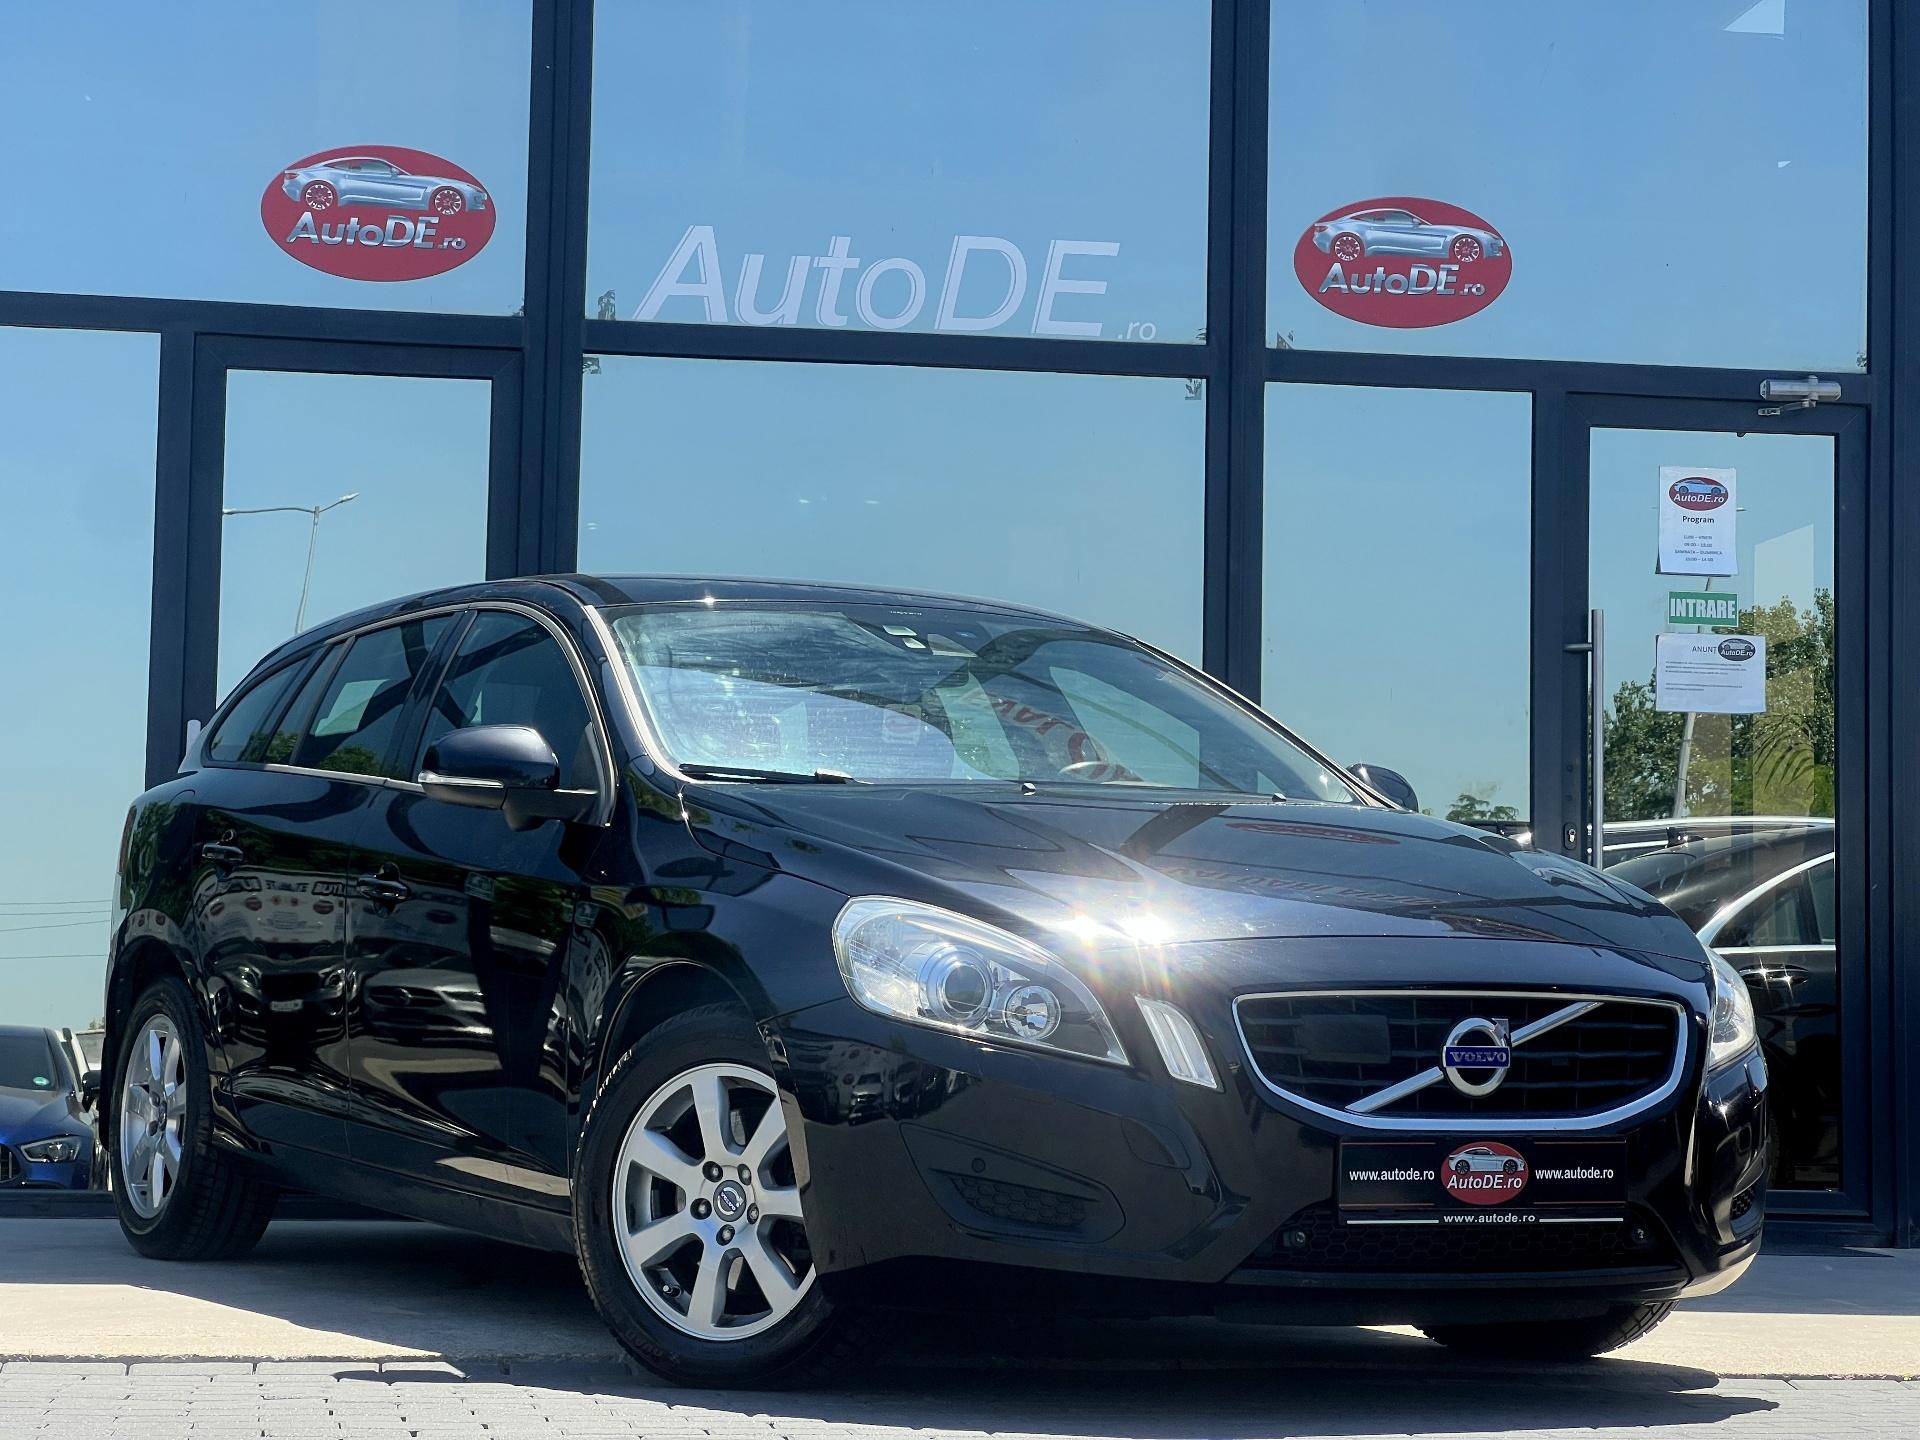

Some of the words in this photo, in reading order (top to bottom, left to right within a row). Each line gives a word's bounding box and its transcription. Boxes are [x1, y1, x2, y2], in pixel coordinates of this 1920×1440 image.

[1673, 493, 1725, 503] AutoDE.ro
[1682, 515, 1715, 524] Program
[1670, 598, 1736, 619] INTRARE
[1449, 1051, 1507, 1063] VOLVO
[1349, 1167, 1435, 1181] www.autode.ro
[1534, 1166, 1614, 1180] www.autode.ro
[1446, 1174, 1523, 1190] AutoDE.ro
[1443, 1212, 1536, 1224] www.autode.ro
